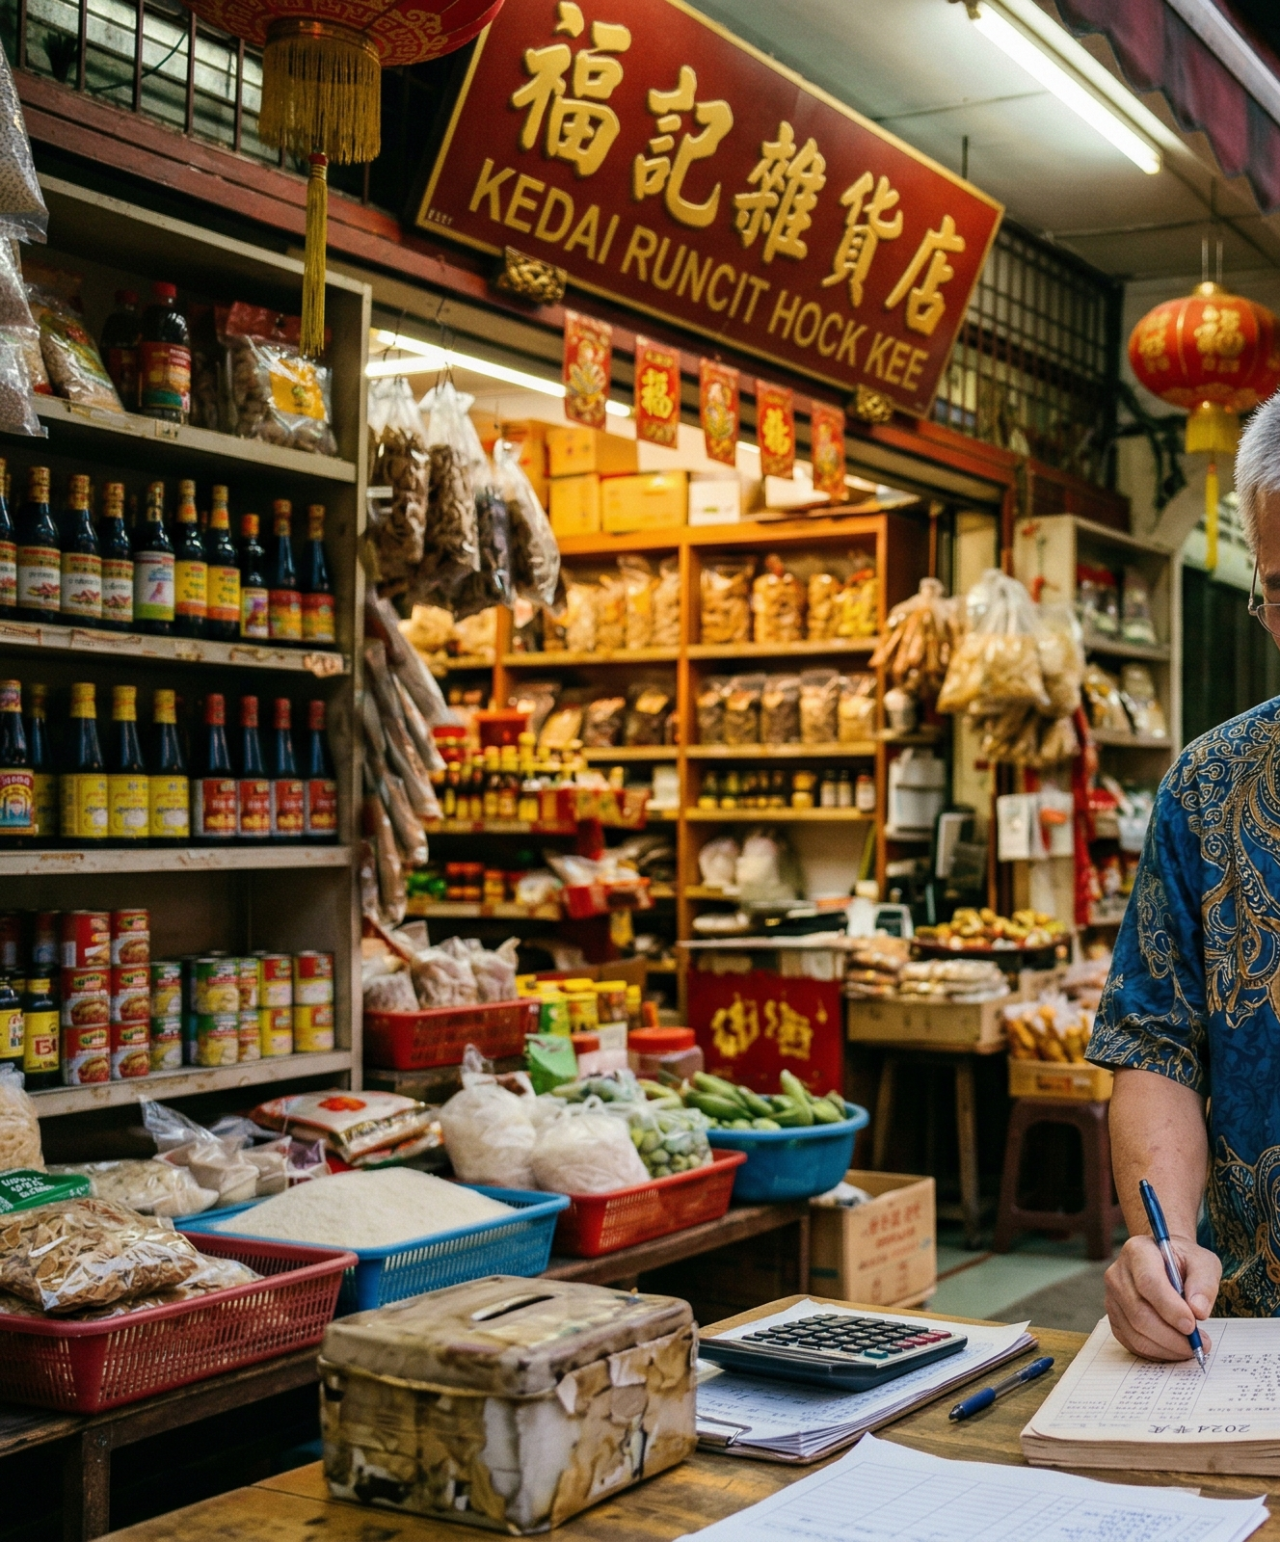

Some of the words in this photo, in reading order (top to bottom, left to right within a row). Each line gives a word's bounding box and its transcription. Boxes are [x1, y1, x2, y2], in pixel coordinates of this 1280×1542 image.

[470, 158, 619, 266] KEDAI
[621, 225, 770, 325] RUNCIT
[768, 289, 868, 367] HOCK
[865, 333, 929, 392] KEE
[511, 1, 966, 336] 福記雜貨店
